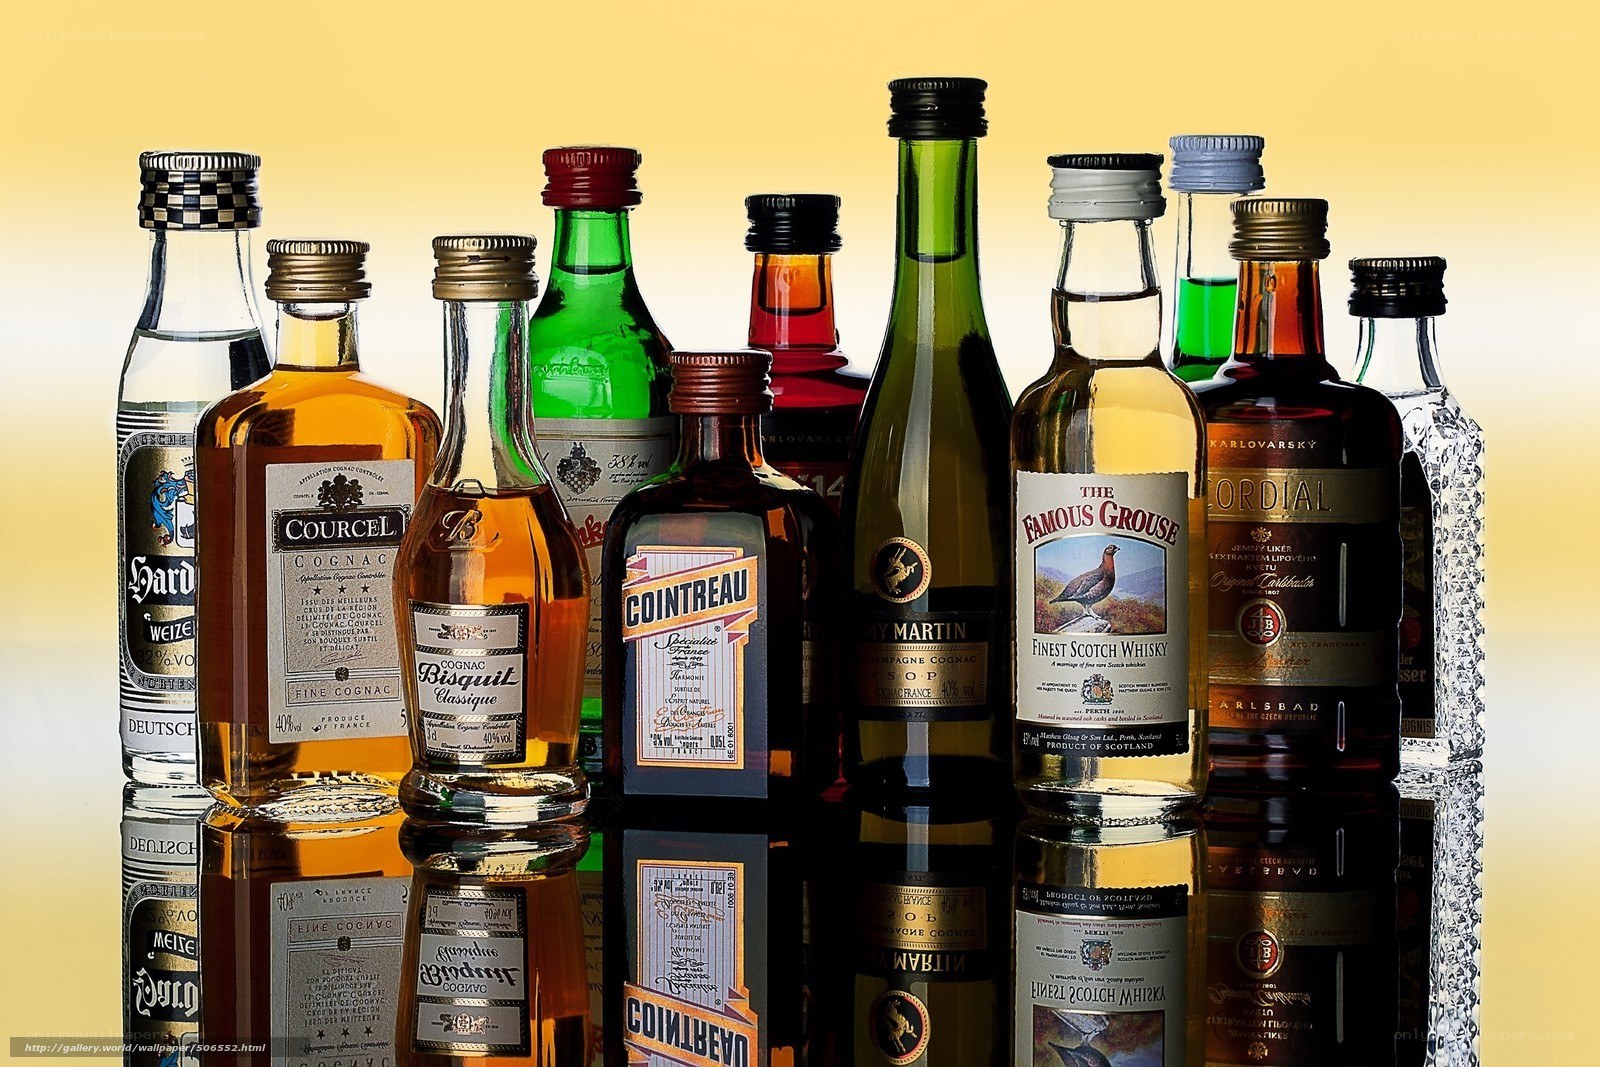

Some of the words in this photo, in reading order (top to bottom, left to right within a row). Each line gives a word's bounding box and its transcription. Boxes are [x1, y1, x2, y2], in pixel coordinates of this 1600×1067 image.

[1079, 486, 1114, 499] THE
[285, 515, 395, 541] COURCEL
[1021, 504, 1094, 545] FAMOUS
[1099, 500, 1181, 547] GROUSE
[294, 553, 387, 568] COGNAC
[626, 568, 748, 628] COINTREAU
[150, 619, 196, 642] WEIZE
[893, 622, 967, 641] MARTIN
[654, 632, 718, 650] Spécialité
[1032, 637, 1068, 658] FINEST
[1070, 640, 1117, 659] SCOTCH
[1120, 640, 1168, 658] WHISKY
[440, 659, 487, 670] COGNAC
[930, 655, 978, 664] COGNAC
[418, 662, 520, 692] Bisquit
[296, 689, 327, 699] FINE
[334, 685, 391, 697] COGNAC
[903, 688, 932, 698] FRANCE
[941, 679, 959, 699] 40%
[433, 687, 498, 712] Classique
[321, 714, 365, 723] PRODUCE
[334, 721, 371, 729] FRANCE
[1046, 741, 1086, 751] PRODUCT
[1089, 742, 1102, 751] OF
[1105, 742, 1154, 751] SCOTLAND
